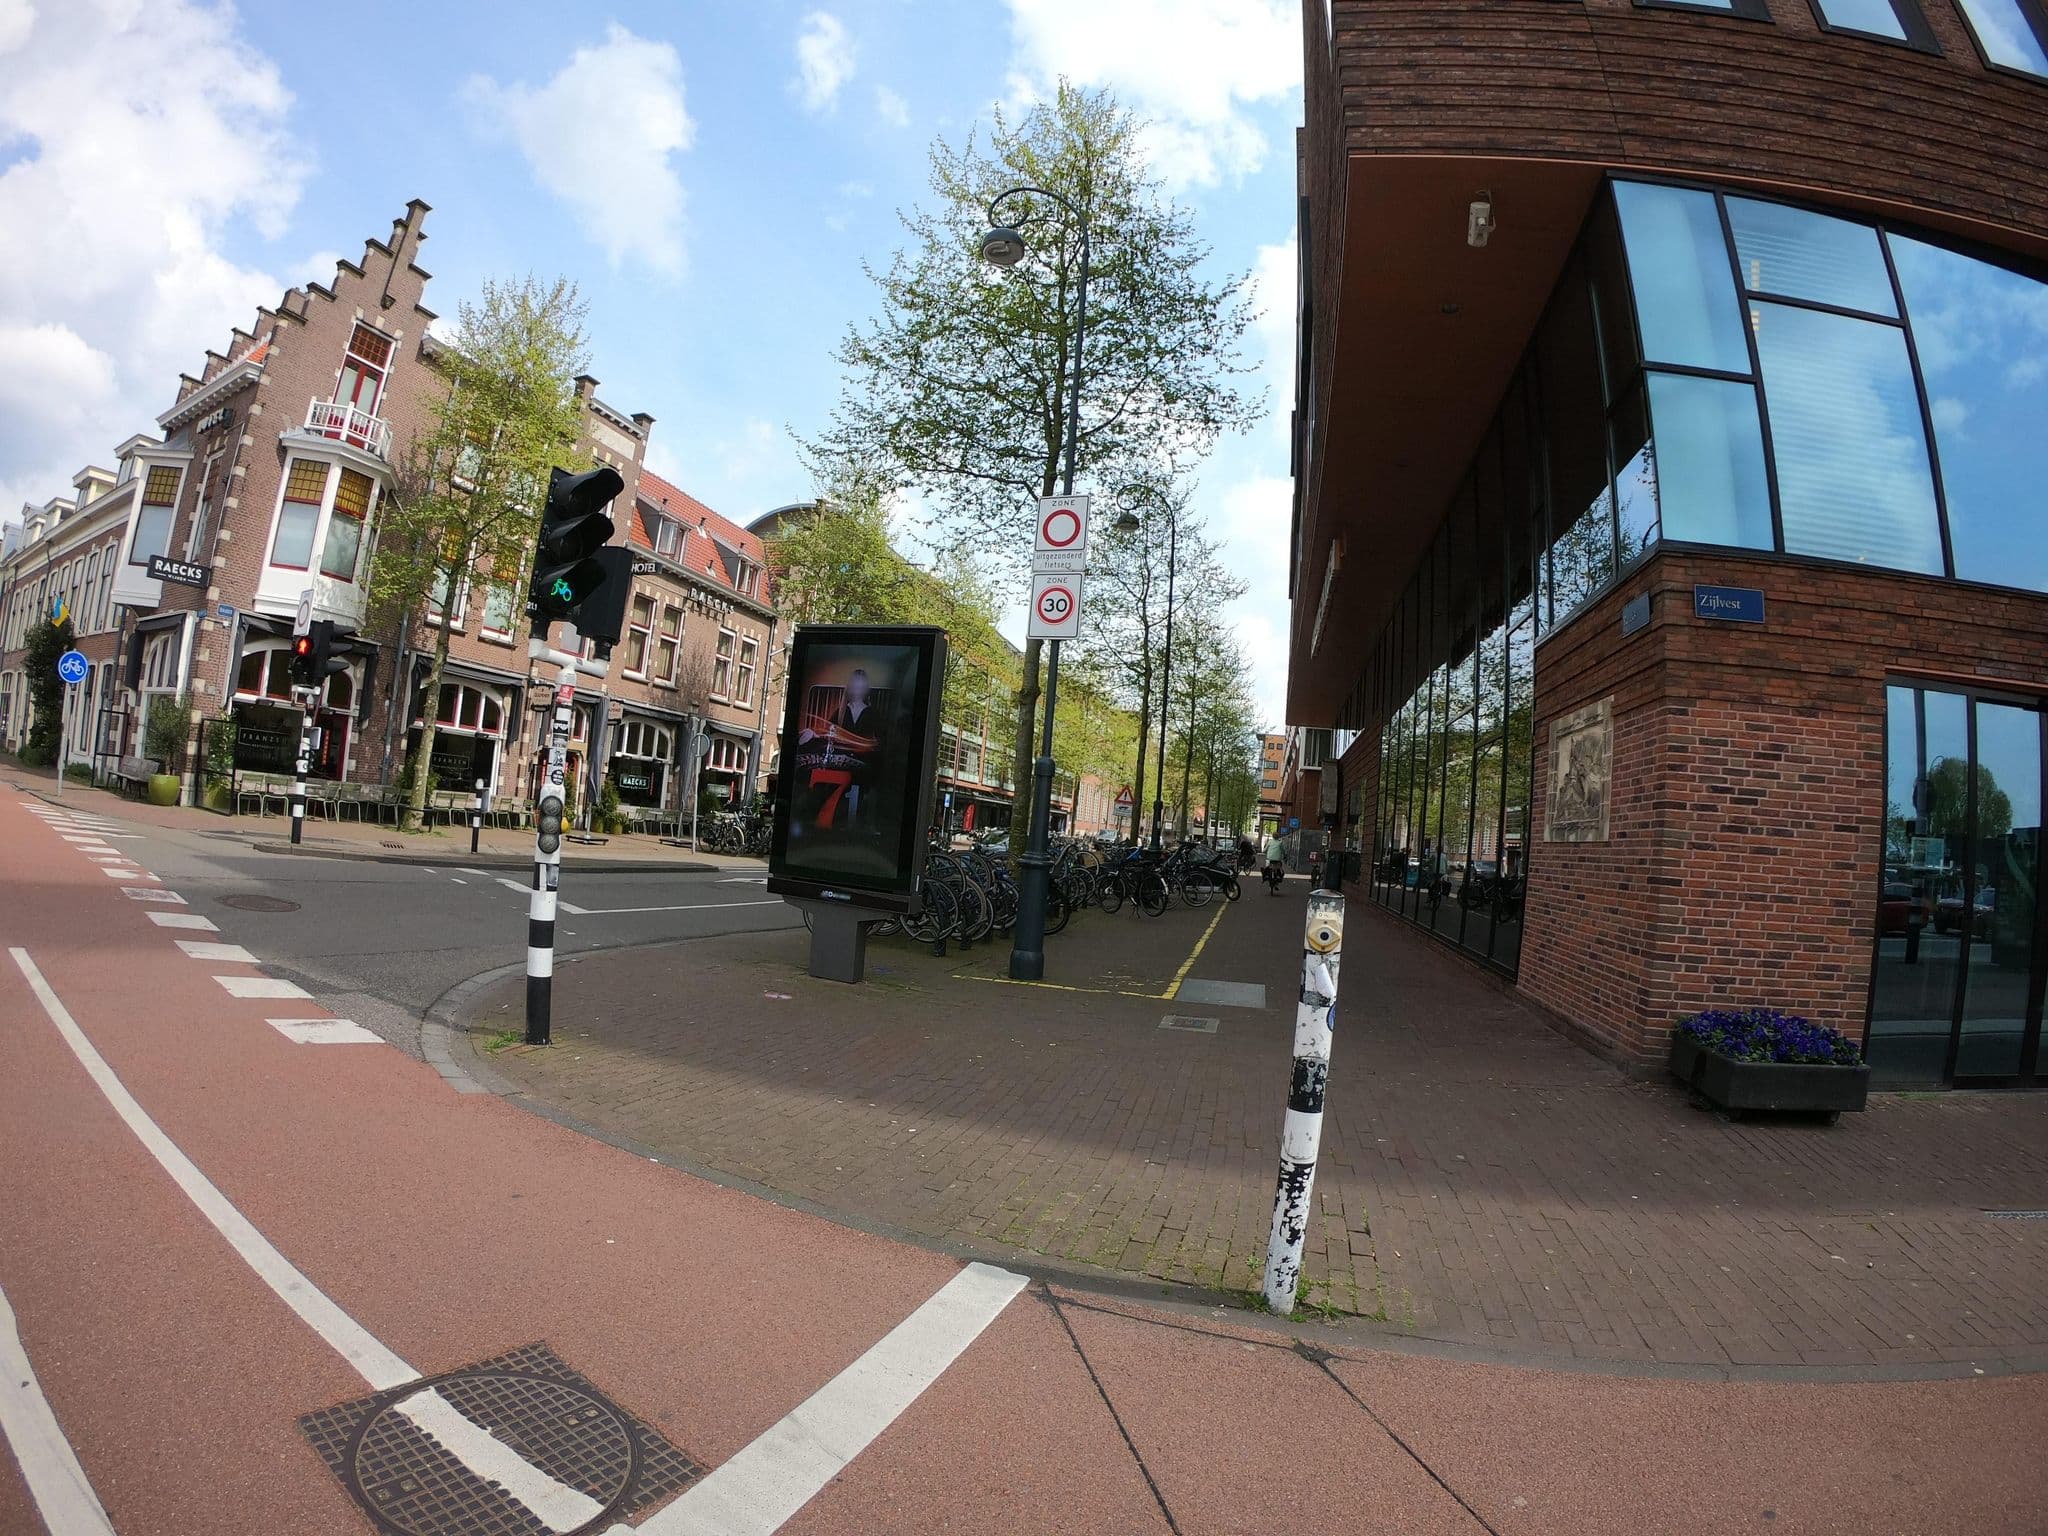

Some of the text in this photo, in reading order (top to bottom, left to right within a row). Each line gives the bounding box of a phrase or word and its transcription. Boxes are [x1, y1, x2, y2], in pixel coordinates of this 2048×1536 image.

[1052, 499, 1076, 507] ZONE
[1036, 552, 1083, 560] uitgezonderd
[155, 559, 203, 579] RAECKS
[631, 562, 656, 573] HOTEL
[690, 587, 735, 614] RAECKS
[1043, 598, 1068, 613] 30
[1699, 594, 1741, 610] Zijlvest
[809, 767, 852, 829] 7
